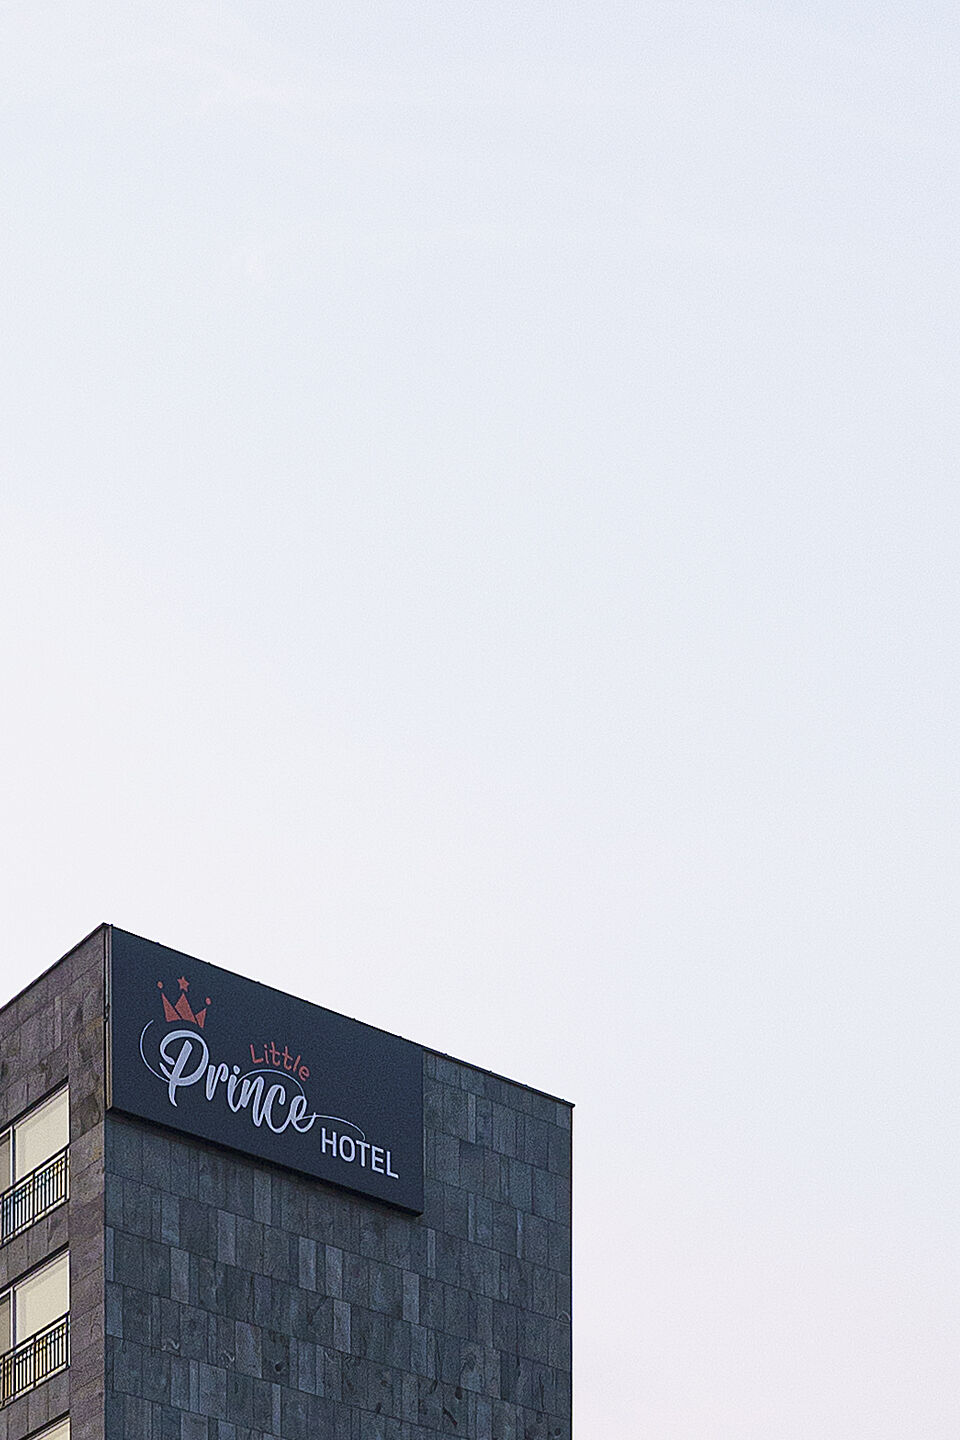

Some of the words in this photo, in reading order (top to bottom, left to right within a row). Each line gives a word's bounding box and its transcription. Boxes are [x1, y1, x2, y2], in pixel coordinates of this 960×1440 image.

[156, 1029, 317, 1134] Prince
[249, 1040, 310, 1082] Little
[321, 1127, 399, 1179] HOTEL
